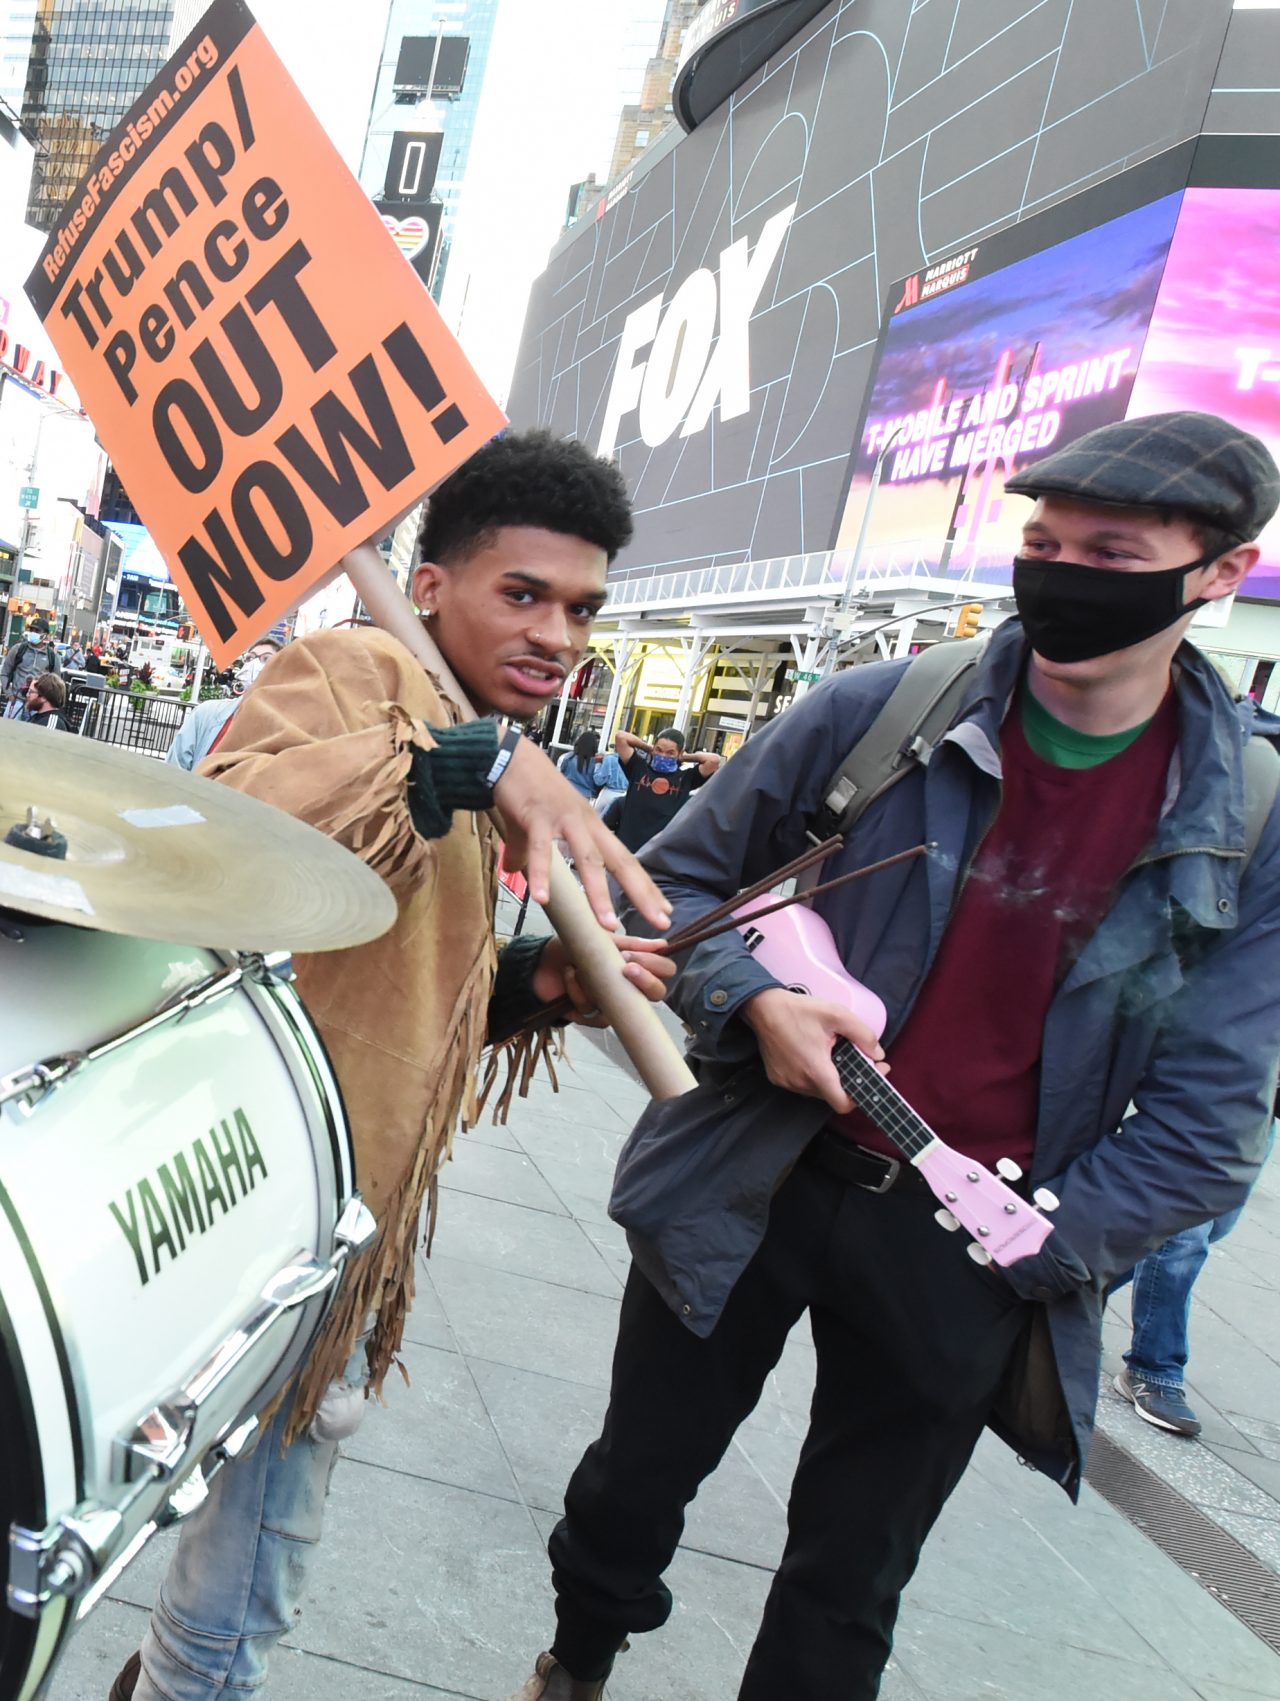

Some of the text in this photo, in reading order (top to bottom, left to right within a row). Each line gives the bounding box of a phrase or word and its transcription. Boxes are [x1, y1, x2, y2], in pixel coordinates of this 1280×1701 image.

[41, 34, 219, 284] RefuseFascism.org
[60, 63, 256, 351] Trump/
[924, 247, 979, 282] MARRIOTT
[102, 176, 290, 408] Pence
[152, 238, 339, 494] OUT
[596, 201, 798, 463] FOX
[921, 267, 968, 298] MARQUIS
[177, 321, 470, 645] NOW!
[866, 347, 1131, 455] T-MOBILE AND SPRINT
[890, 411, 1061, 482] HAVE MERGED
[108, 1106, 268, 1287] YAMAHA
